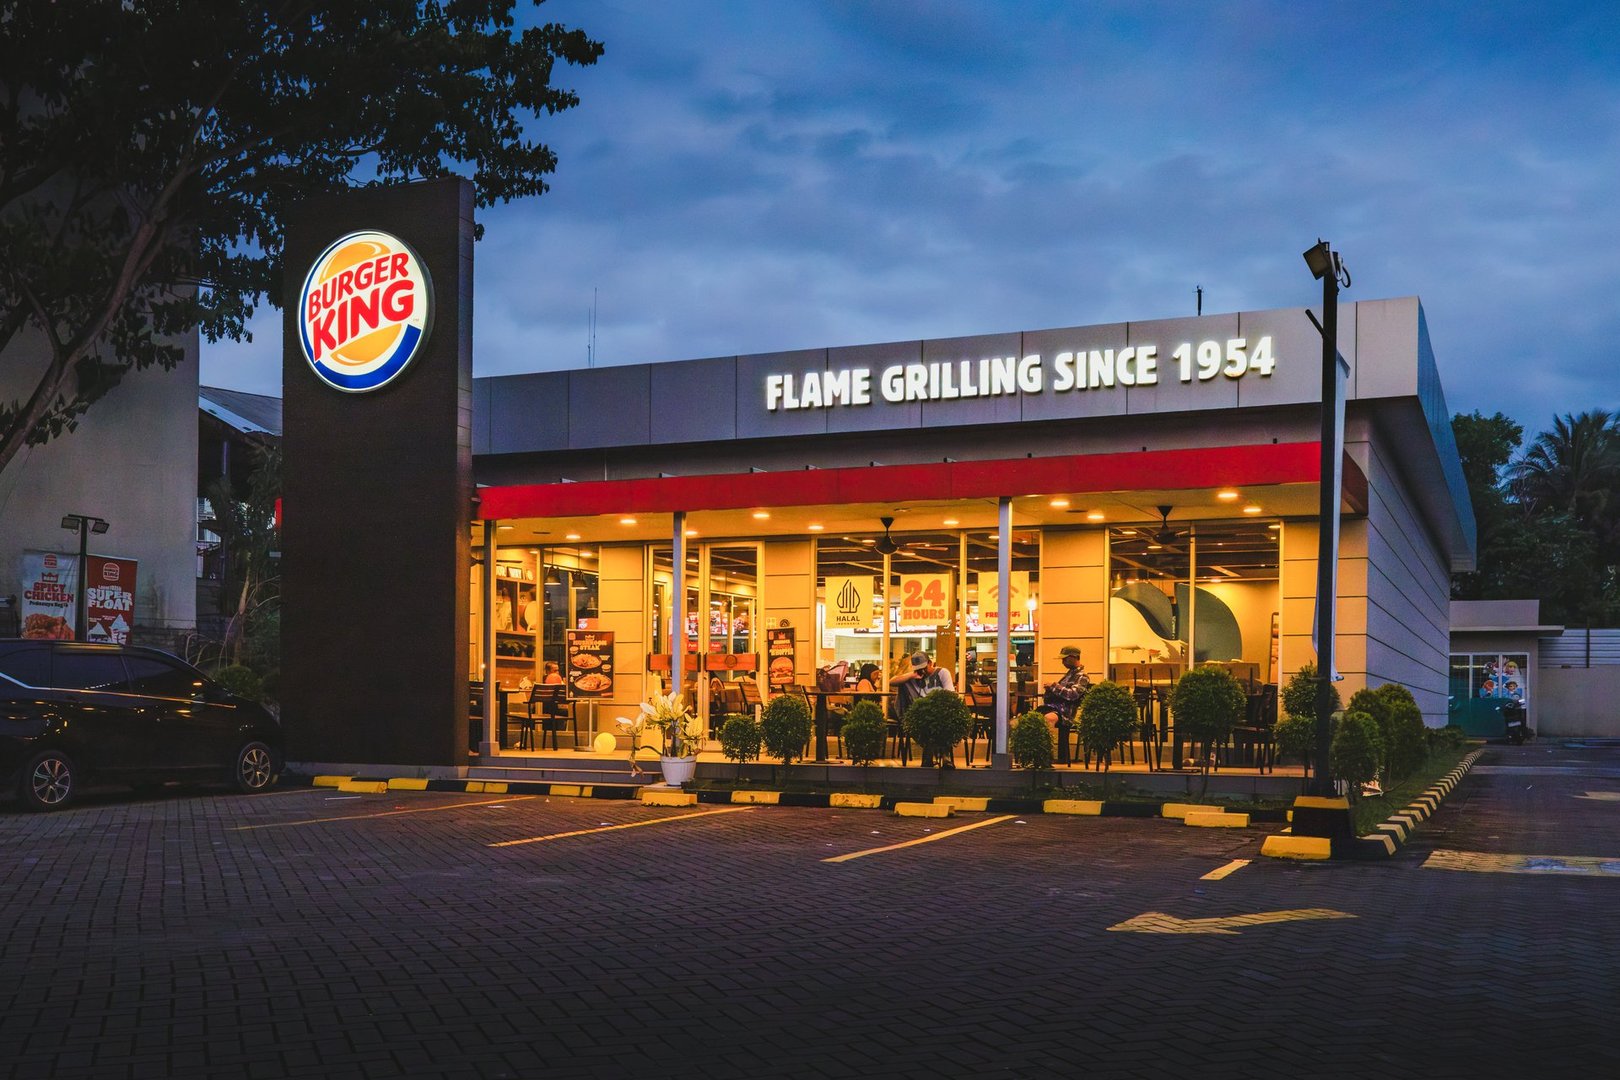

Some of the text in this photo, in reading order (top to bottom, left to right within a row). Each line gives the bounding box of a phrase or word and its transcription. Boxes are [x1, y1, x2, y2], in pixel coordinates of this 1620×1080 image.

[308, 252, 409, 323] BURGER
[313, 279, 415, 362] KING
[766, 336, 1276, 411] FLAME GRILLING SINCE 1954
[33, 581, 66, 593] SPICY
[87, 587, 132, 602] SUPER
[903, 579, 946, 608] 24
[24, 590, 75, 603] CHICKEN
[88, 598, 133, 611] FLOAT
[903, 608, 946, 620] HOURS
